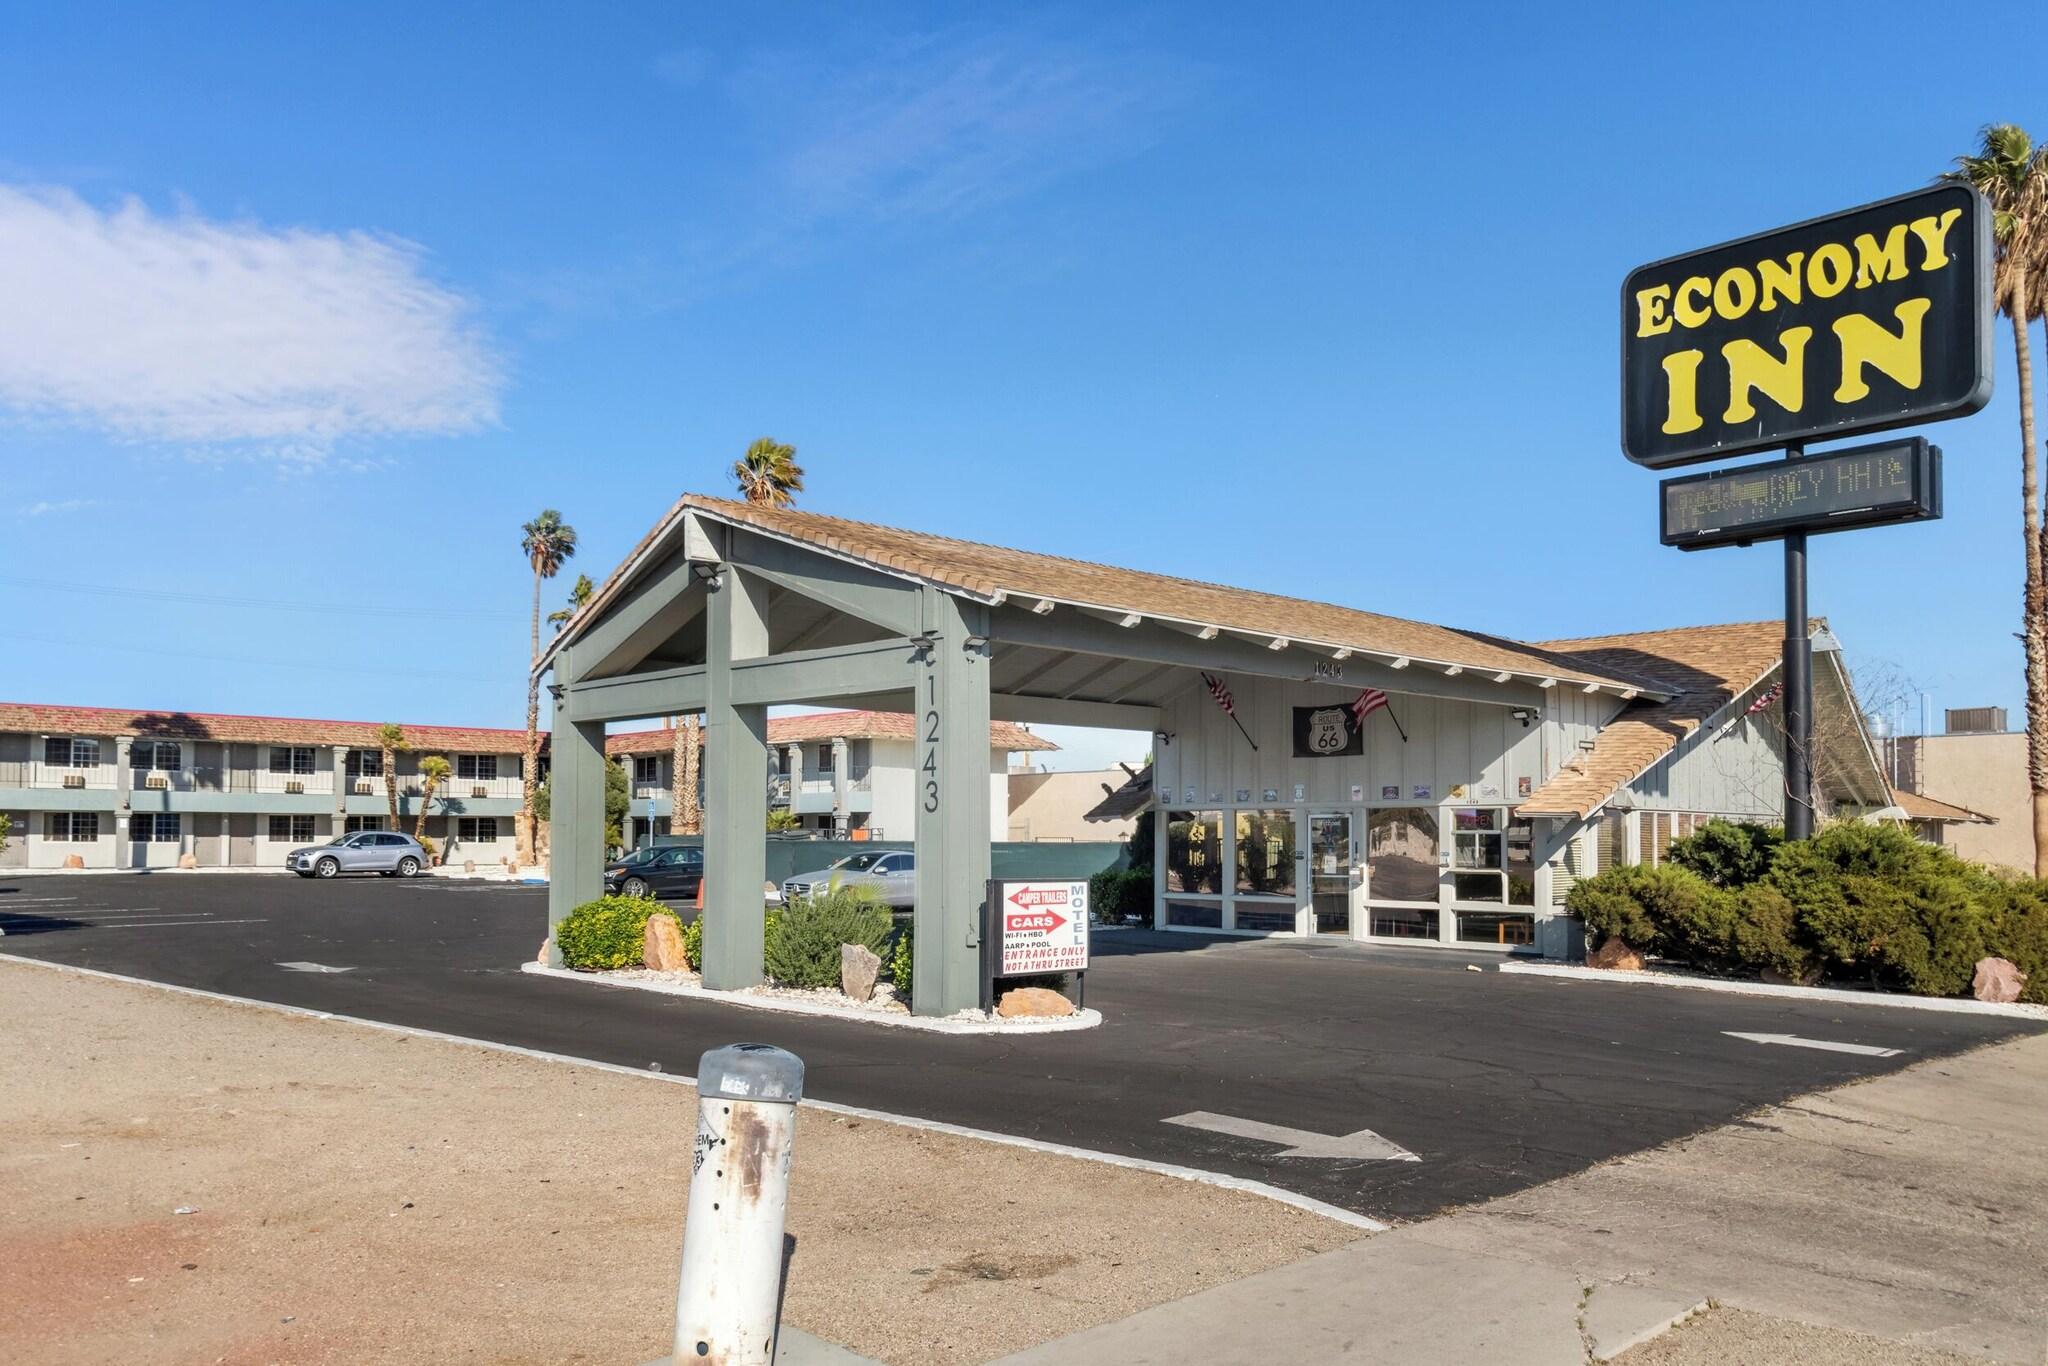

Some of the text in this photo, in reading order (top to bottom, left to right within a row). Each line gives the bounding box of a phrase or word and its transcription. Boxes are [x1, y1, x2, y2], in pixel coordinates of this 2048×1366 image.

[1636, 208, 1962, 338] ECONOMY
[1661, 297, 1932, 435] INN
[1314, 661, 1343, 680] 1243
[1318, 714, 1341, 723] ROUTE
[922, 674, 940, 813] 1243
[1318, 732, 1338, 749] 66
[1018, 891, 1067, 905] CAMPER TRAILERS
[1011, 916, 1054, 928] CARS
[1071, 885, 1084, 946] MOTEL
[1005, 946, 1085, 960] ENTRANCE ONLY
[1005, 958, 1085, 972] NOT A THRU STREET
